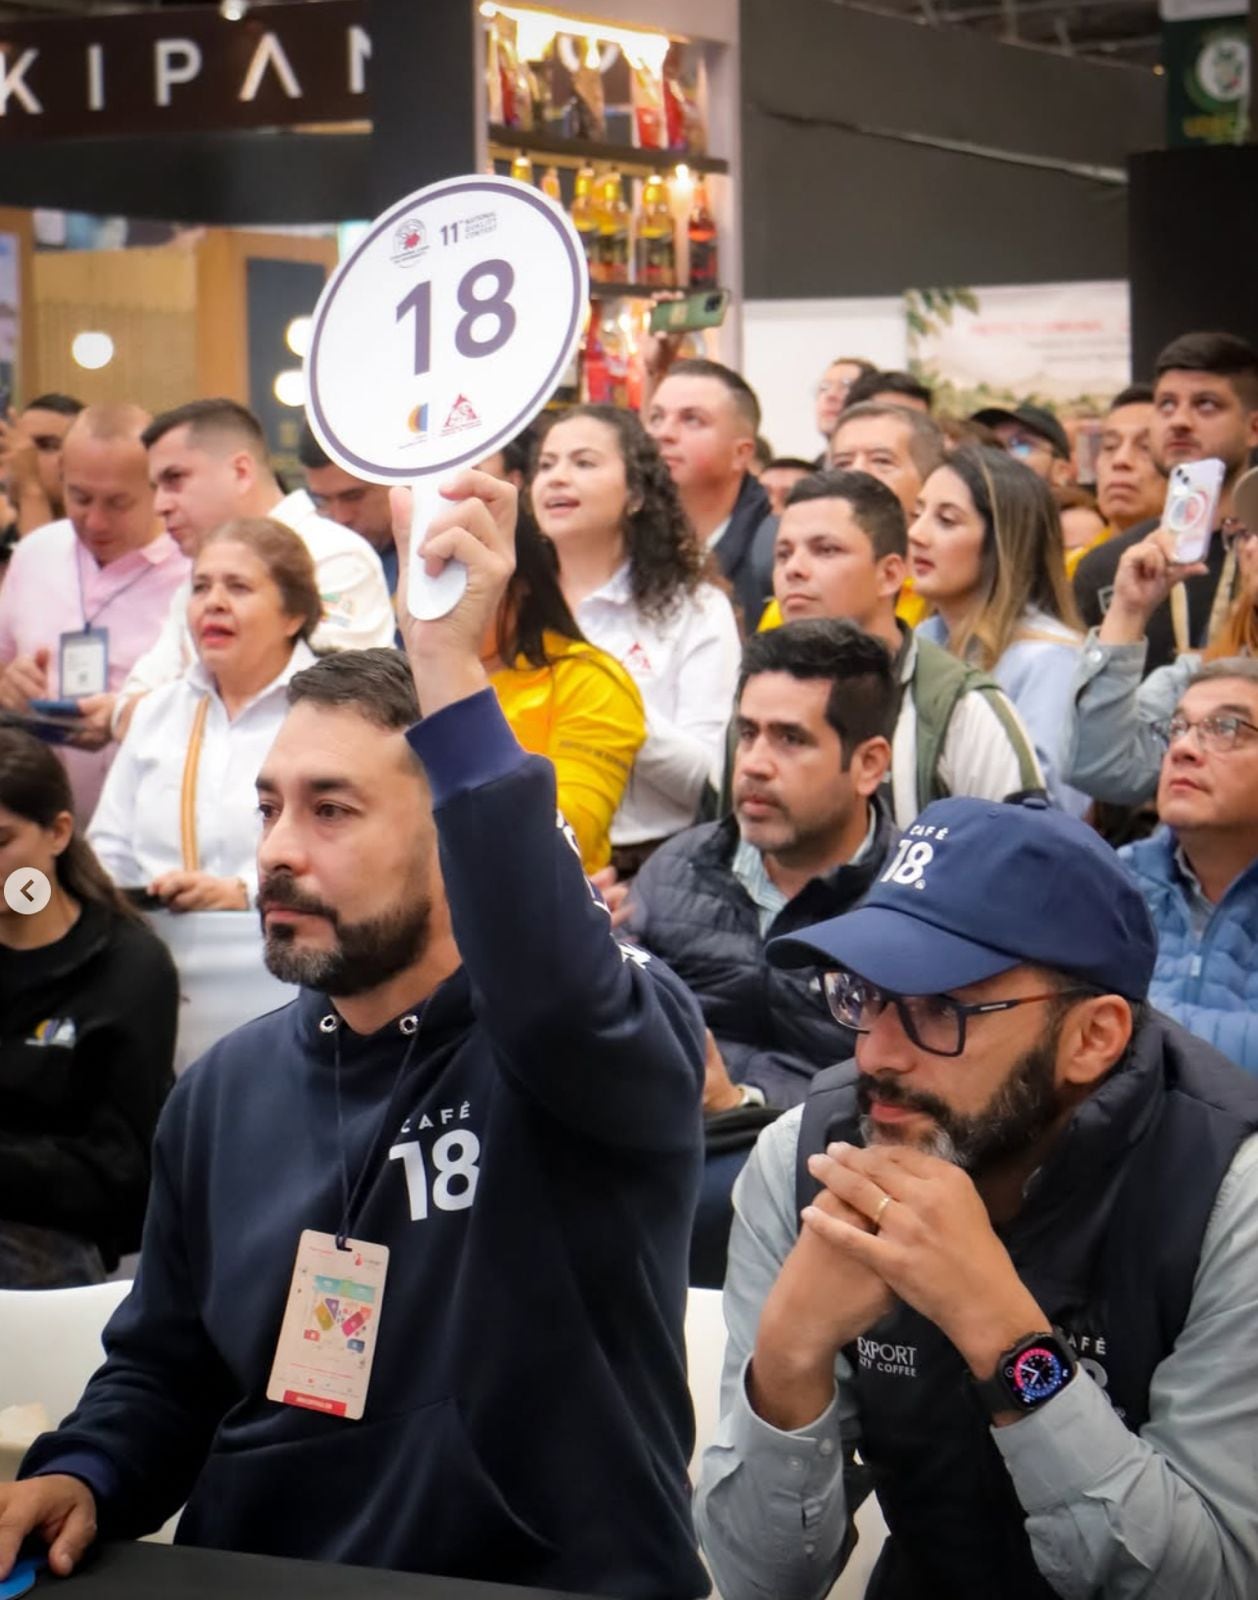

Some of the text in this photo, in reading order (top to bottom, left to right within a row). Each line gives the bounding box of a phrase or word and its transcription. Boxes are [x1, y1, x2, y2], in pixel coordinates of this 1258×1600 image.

[396, 258, 516, 375] 18
[400, 1100, 471, 1133] CAFÉ
[388, 1128, 480, 1221] 18
[1067, 1332, 1106, 1355] AFÉ
[876, 1362, 917, 1377] COFFEE
